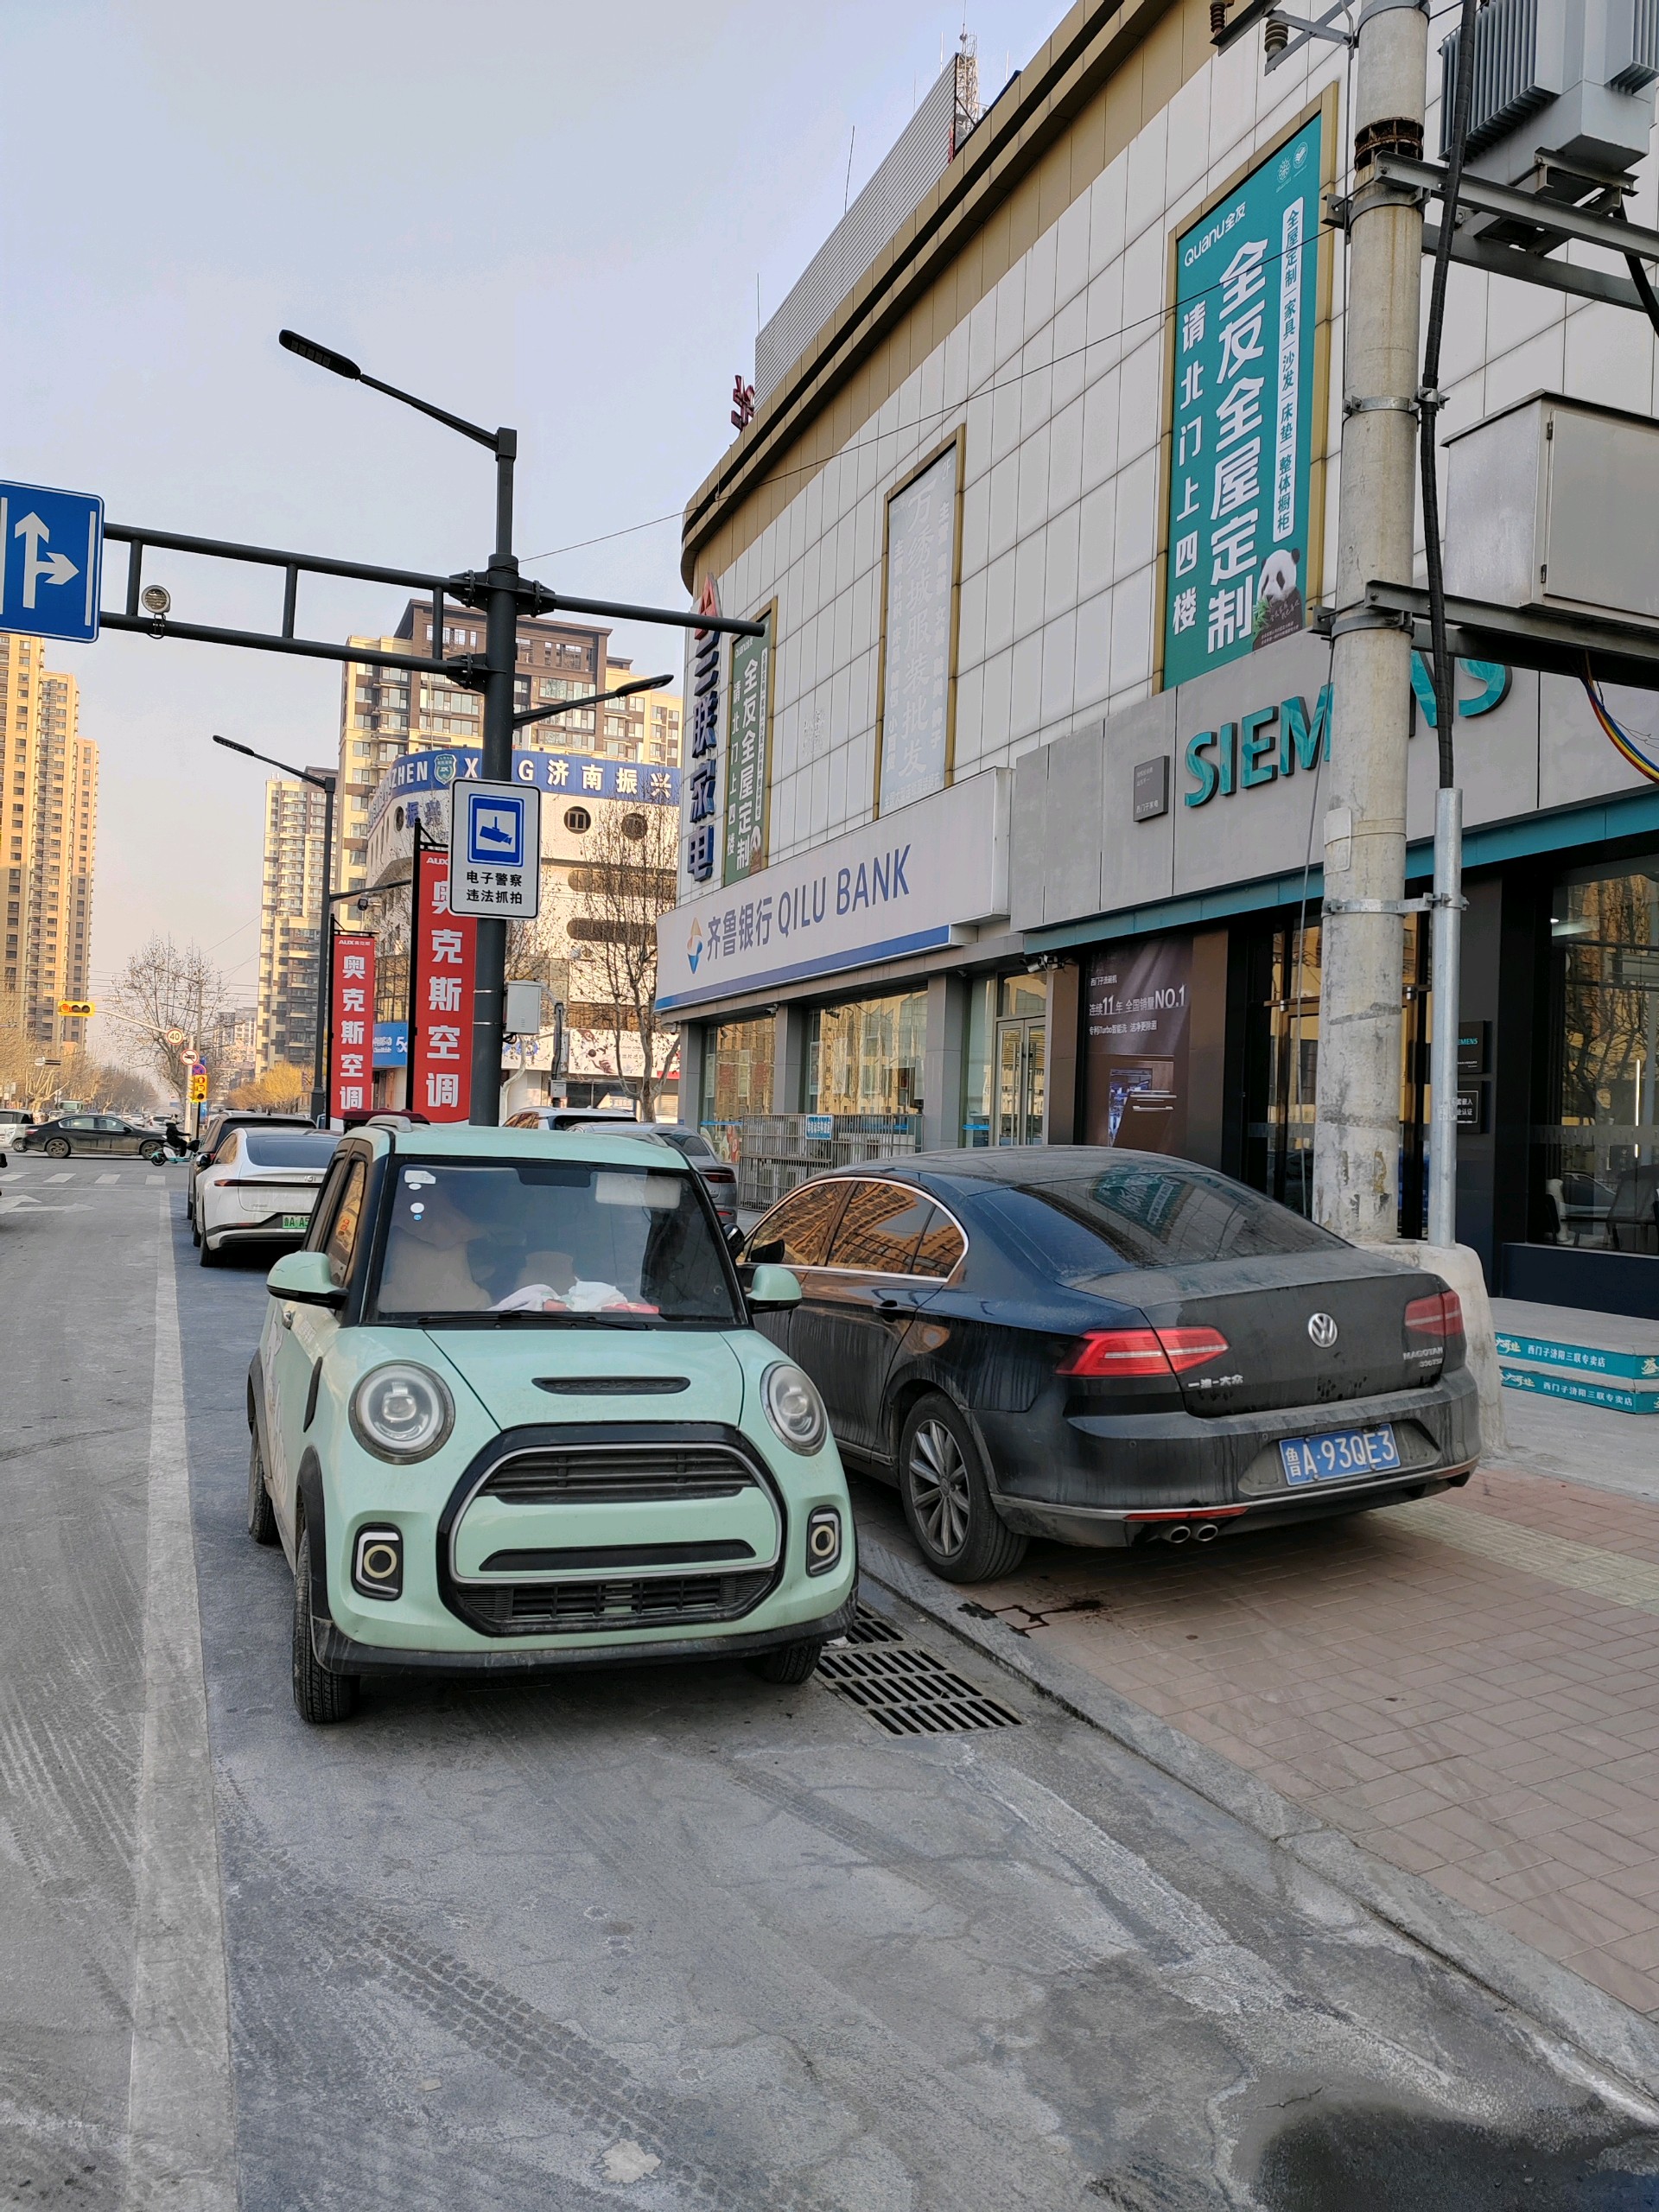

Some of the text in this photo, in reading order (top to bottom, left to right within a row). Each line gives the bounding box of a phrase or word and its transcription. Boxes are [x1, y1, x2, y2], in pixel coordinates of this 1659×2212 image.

[1283, 209, 1300, 289] 全屋定制
[1281, 298, 1297, 340] 家具
[1281, 353, 1295, 391] 沙发
[1280, 402, 1294, 443] 床垫
[1173, 299, 1206, 635] 请北门上四楼
[1207, 238, 1268, 654] 全友全屋定制
[1277, 456, 1293, 532] 整体橱柜
[1185, 650, 1510, 808] SIEMNS
[391, 760, 429, 789] ZHEN
[464, 757, 534, 780] XG
[689, 628, 721, 882] 三联家电
[727, 680, 741, 857] 请北门上四楼
[736, 658, 759, 871] 全友全屋定制
[548, 758, 672, 798] 济南振兴
[467, 870, 523, 887] 电子警察
[467, 888, 523, 905] 违法抓拍
[708, 843, 912, 962] 齐鲁银行 QILU BANK
[1089, 994, 1123, 1015] 连续11年
[340, 955, 365, 1110] 奥克斯空调
[1402, 1346, 1443, 1360] MAGOTAN
[1527, 1344, 1606, 1368] 西门子济阳三联专卖店
[1542, 1381, 1633, 1407] 西门子济阳三联专卖店
